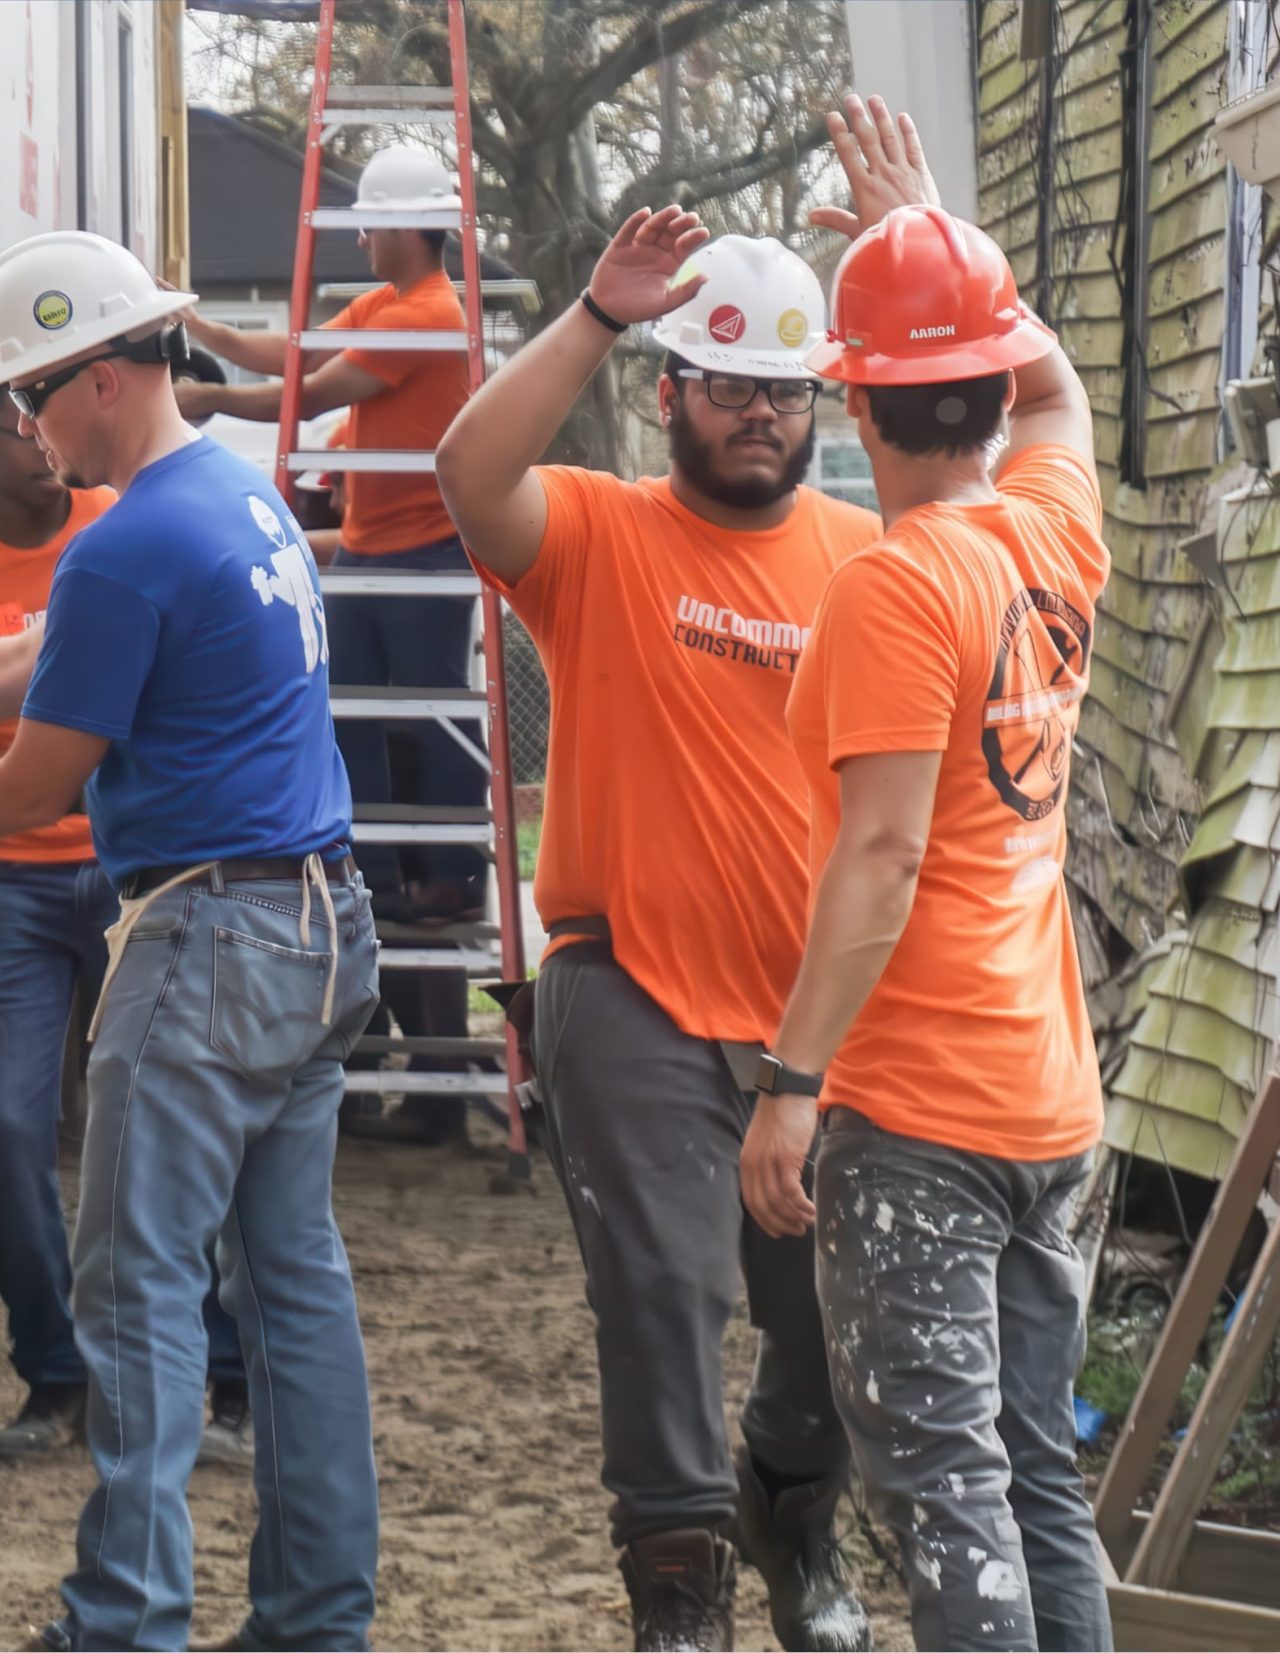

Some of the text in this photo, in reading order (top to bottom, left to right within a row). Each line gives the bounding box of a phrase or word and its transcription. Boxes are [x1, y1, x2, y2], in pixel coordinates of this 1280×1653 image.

[909, 324, 956, 340] AARON
[677, 594, 812, 650] UNCOMMO
[674, 623, 800, 673] CONSTRUCT
